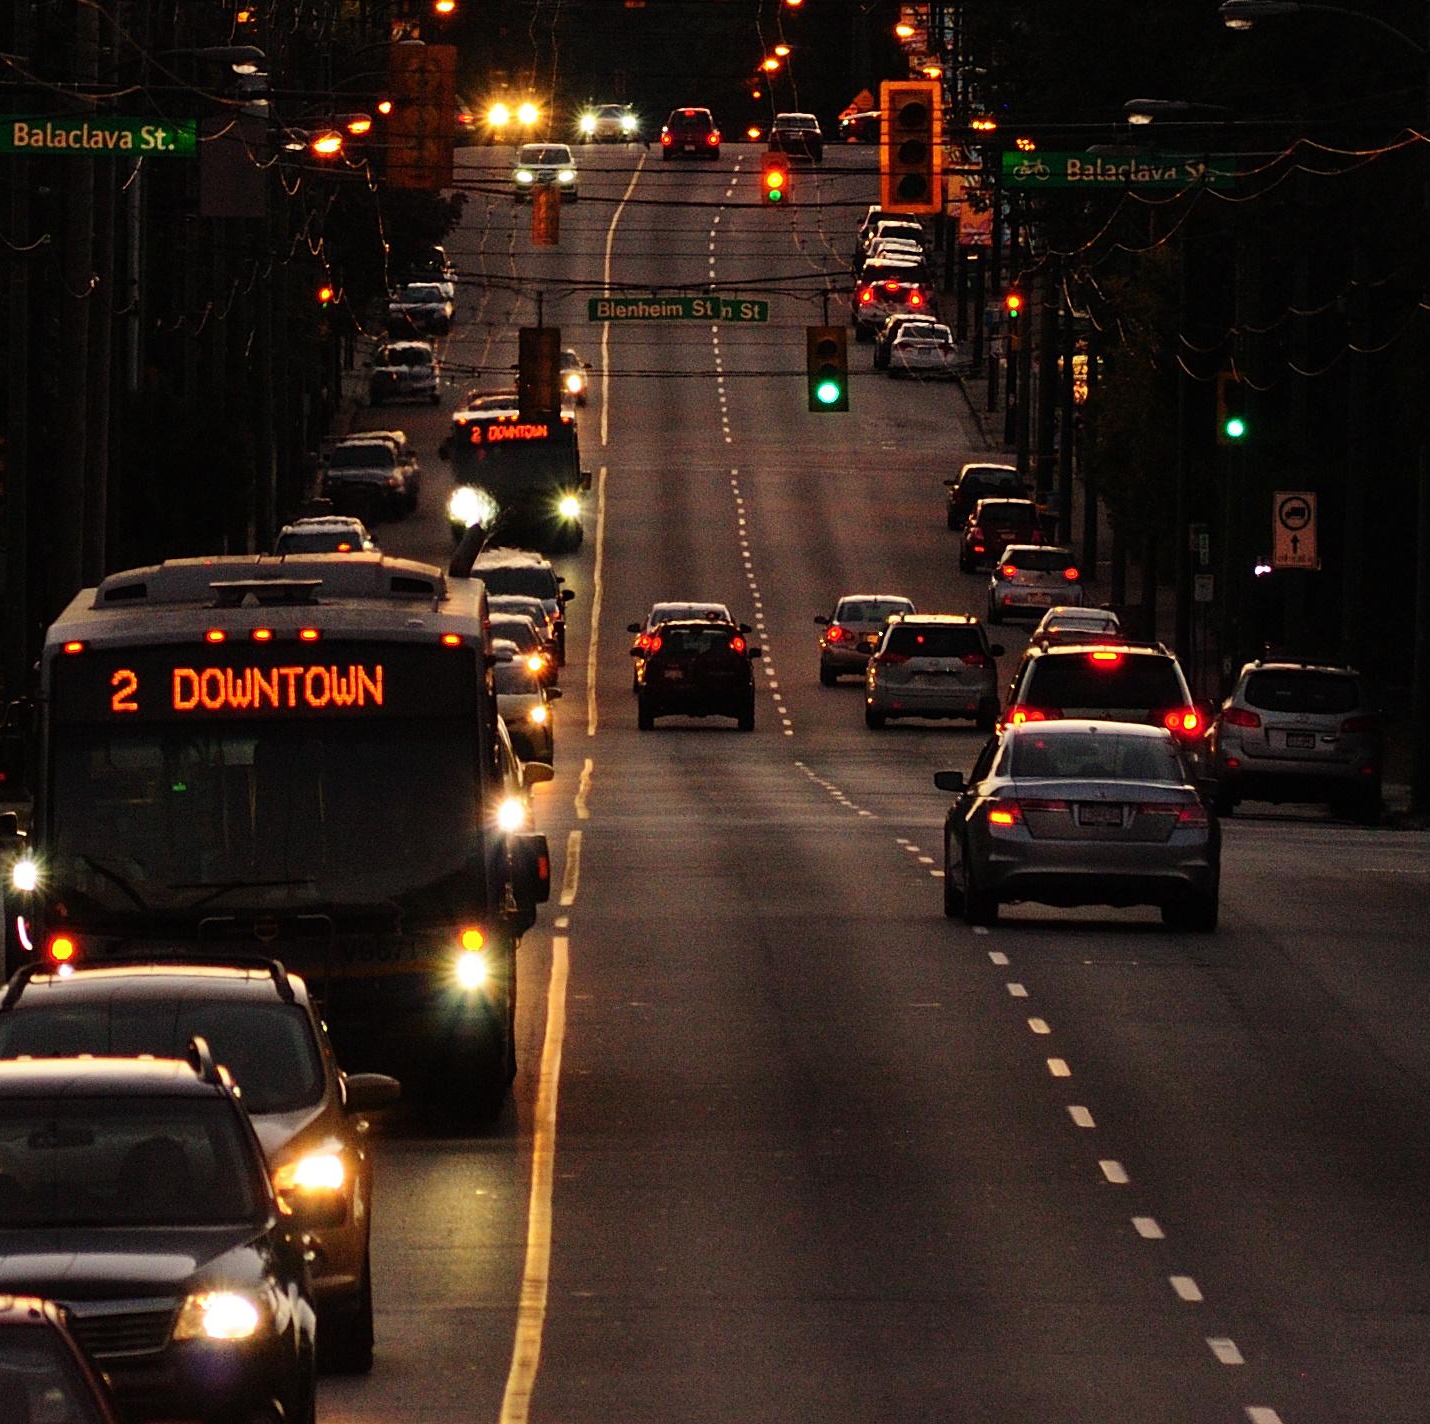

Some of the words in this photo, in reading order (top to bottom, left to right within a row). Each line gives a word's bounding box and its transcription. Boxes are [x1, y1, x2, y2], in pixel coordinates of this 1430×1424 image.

[13, 122, 132, 149] Balaclava
[140, 126, 175, 150] St.
[1066, 159, 1179, 181] Balaclava
[597, 299, 683, 318] Blenheim
[692, 299, 713, 317] St
[740, 303, 761, 319] St
[471, 426, 482, 444] 2
[488, 424, 548, 442] DOWNTOWN
[112, 669, 138, 711] 2
[173, 665, 383, 710] DOWNTOWN
